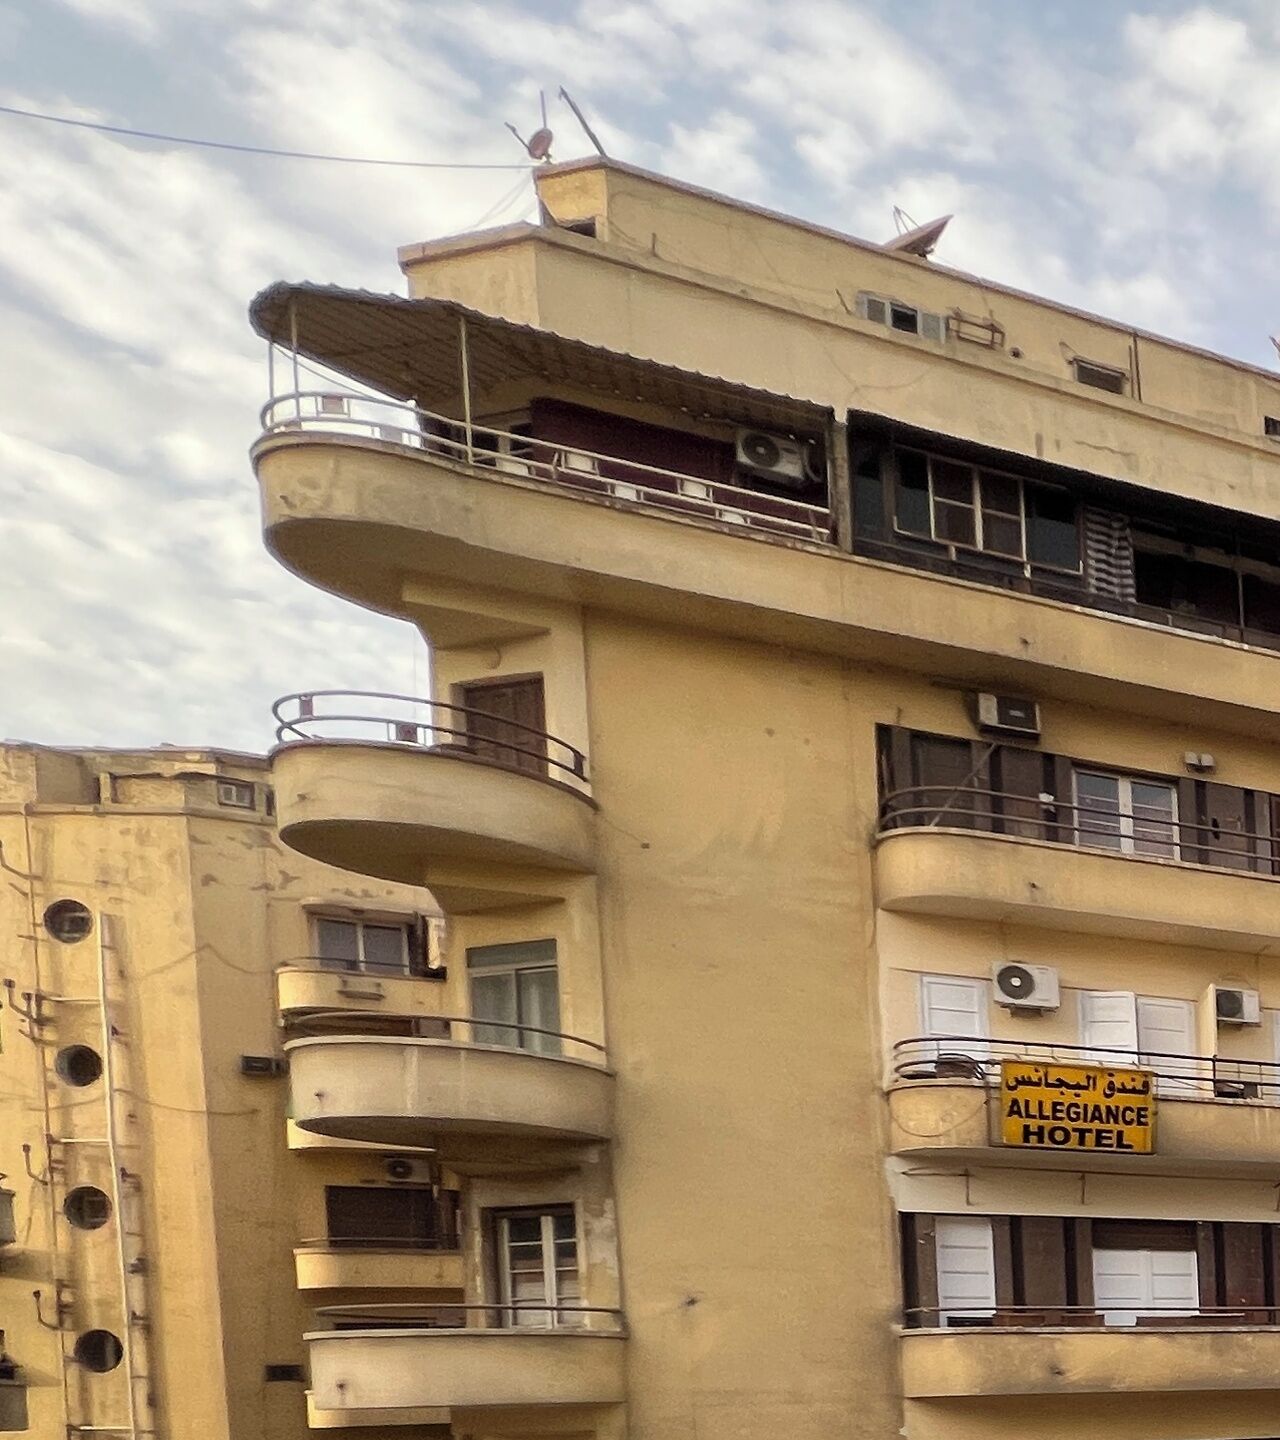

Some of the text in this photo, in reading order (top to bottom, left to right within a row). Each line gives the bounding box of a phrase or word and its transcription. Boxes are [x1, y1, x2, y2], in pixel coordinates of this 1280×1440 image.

[1103, 1072, 1150, 1098] فندق
[1007, 1097, 1149, 1127] ALLEGIANCE
[1022, 1123, 1134, 1150] HOTEL
